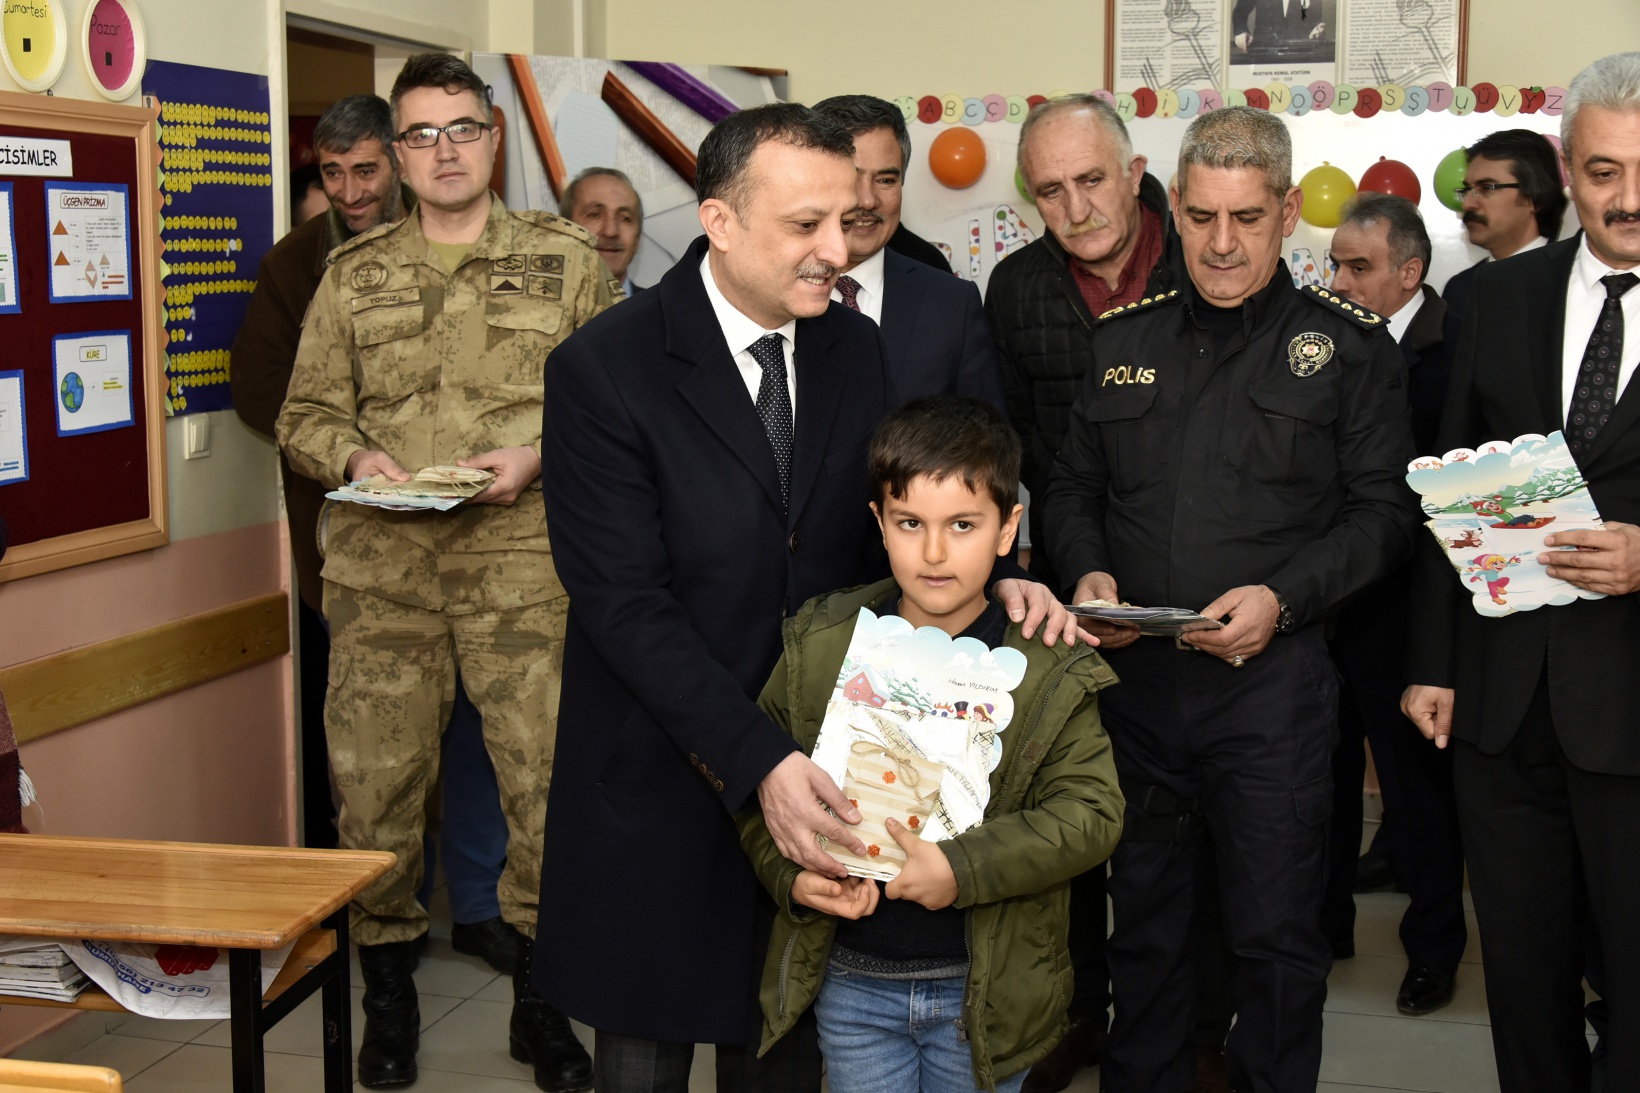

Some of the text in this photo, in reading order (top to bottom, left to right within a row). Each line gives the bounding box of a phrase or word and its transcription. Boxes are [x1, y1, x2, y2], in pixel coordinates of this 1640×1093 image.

[91, 14, 121, 36] Pazar
[923, 102, 934, 116] A
[944, 101, 956, 116] B
[965, 103, 978, 117] C
[987, 101, 999, 117] Ç
[1010, 103, 1020, 116] D
[1118, 101, 1131, 114] H
[1180, 96, 1189, 111] J
[1203, 97, 1215, 110] K
[1247, 96, 1262, 110] M
[1271, 90, 1283, 104] N
[1292, 93, 1305, 108] O
[1314, 86, 1326, 103] Ö
[1338, 91, 1350, 106] P
[1361, 95, 1373, 111] R
[1384, 89, 1395, 105] S
[1408, 92, 1420, 111] Ş
[1432, 88, 1445, 103] T
[1478, 87, 1491, 104] Ü
[1501, 93, 1516, 110] V
[1525, 93, 1537, 109] Y
[1547, 94, 1563, 110] Z
[63, 196, 106, 208] ÜÇGEN PRİZMA
[369, 296, 397, 304] TOPUZ
[86, 349, 100, 359] KÜRE
